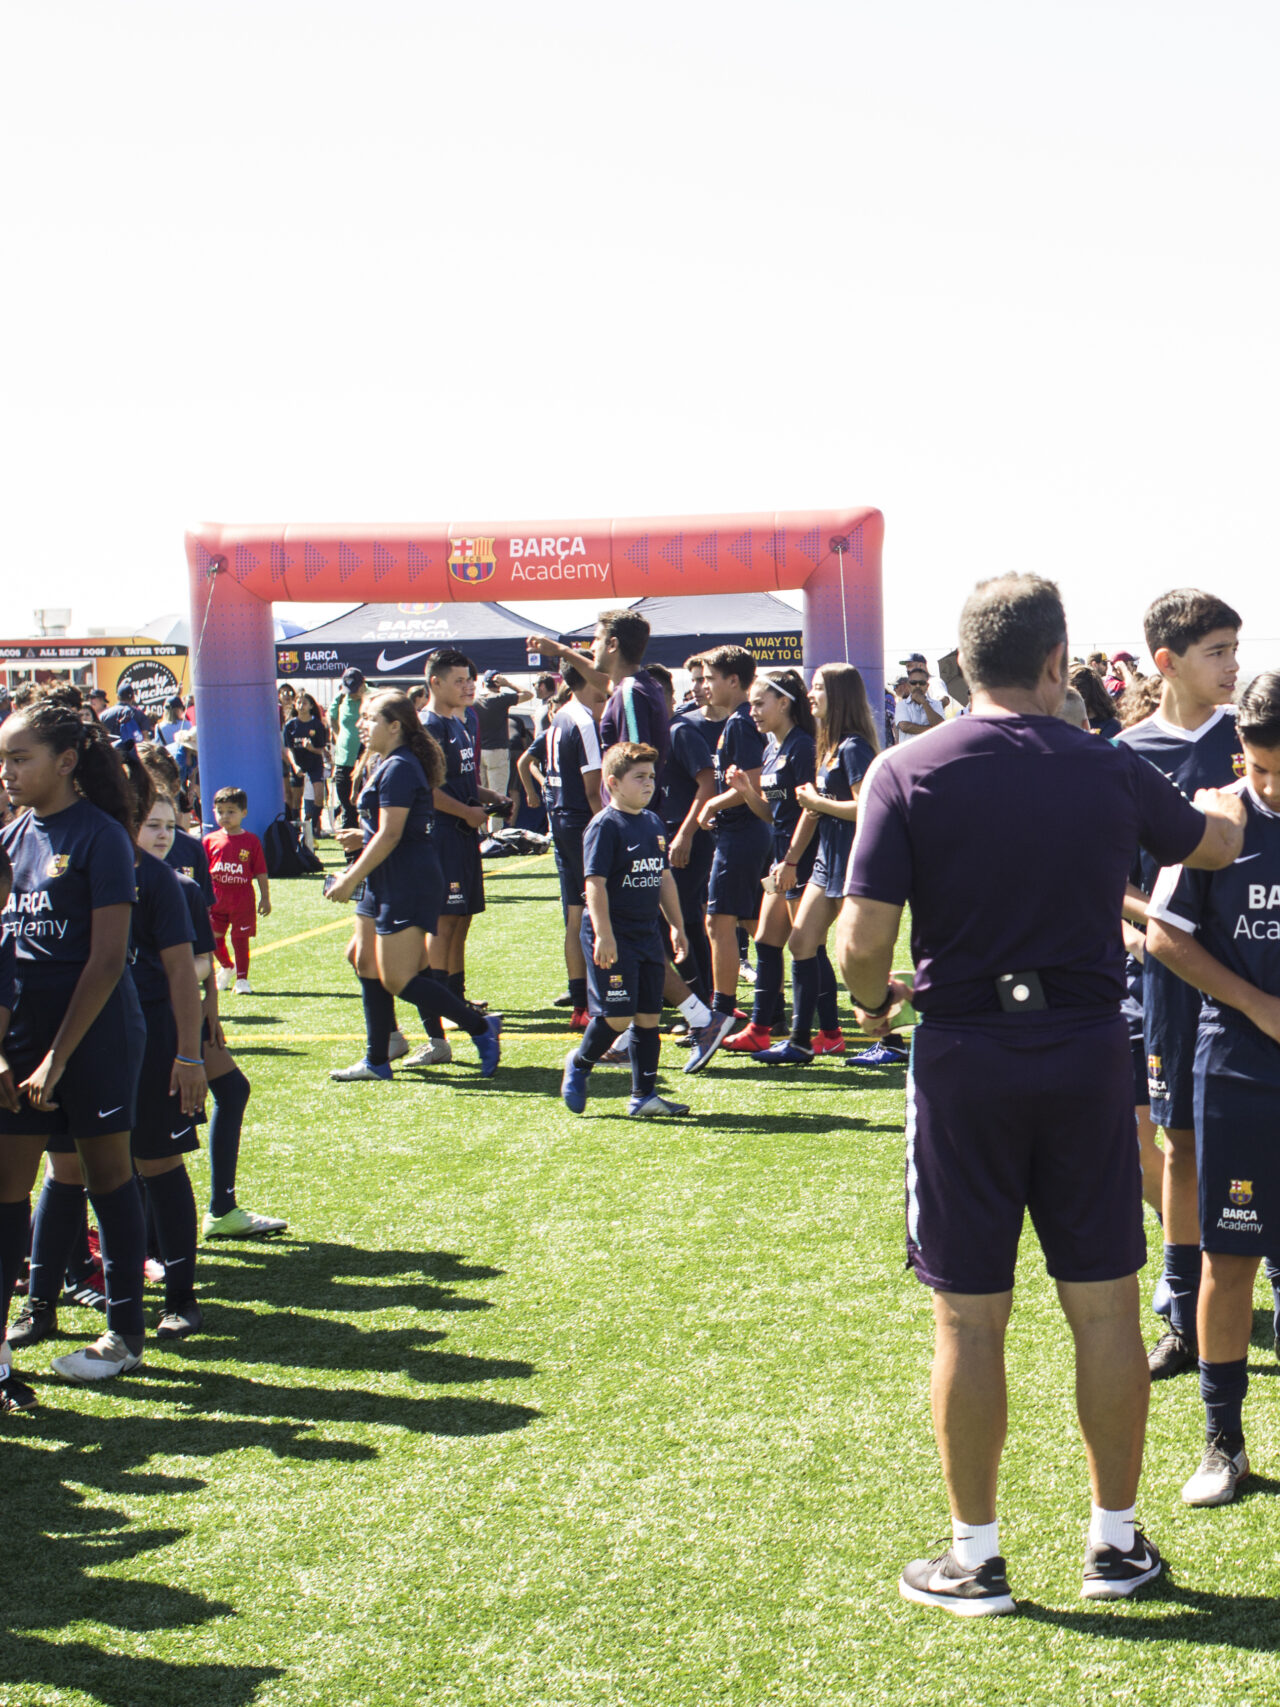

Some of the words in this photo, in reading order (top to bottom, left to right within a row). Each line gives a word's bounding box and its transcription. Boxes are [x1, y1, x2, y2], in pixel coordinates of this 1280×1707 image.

[509, 536, 586, 560] BARÇA
[510, 560, 610, 582] Academy
[378, 619, 449, 632] BARÇA
[361, 629, 459, 640] Academy
[745, 637, 753, 647] A
[755, 637, 781, 647] WAY
[783, 636, 797, 647] TO
[0, 648, 21, 657] ACOS
[40, 648, 57, 656] ALL
[82, 647, 106, 656] DOGS
[124, 647, 152, 656] TATER
[153, 646, 176, 655] TOTS
[303, 650, 338, 661] BARÇA
[777, 650, 791, 660] TO
[304, 657, 349, 672] Academy
[118, 672, 169, 692] Gnarly
[212, 861, 244, 875] ARÇA
[1, 890, 54, 917] ARÇA
[1222, 1207, 1259, 1222] BARÇA
[1216, 1218, 1263, 1234] Academy
